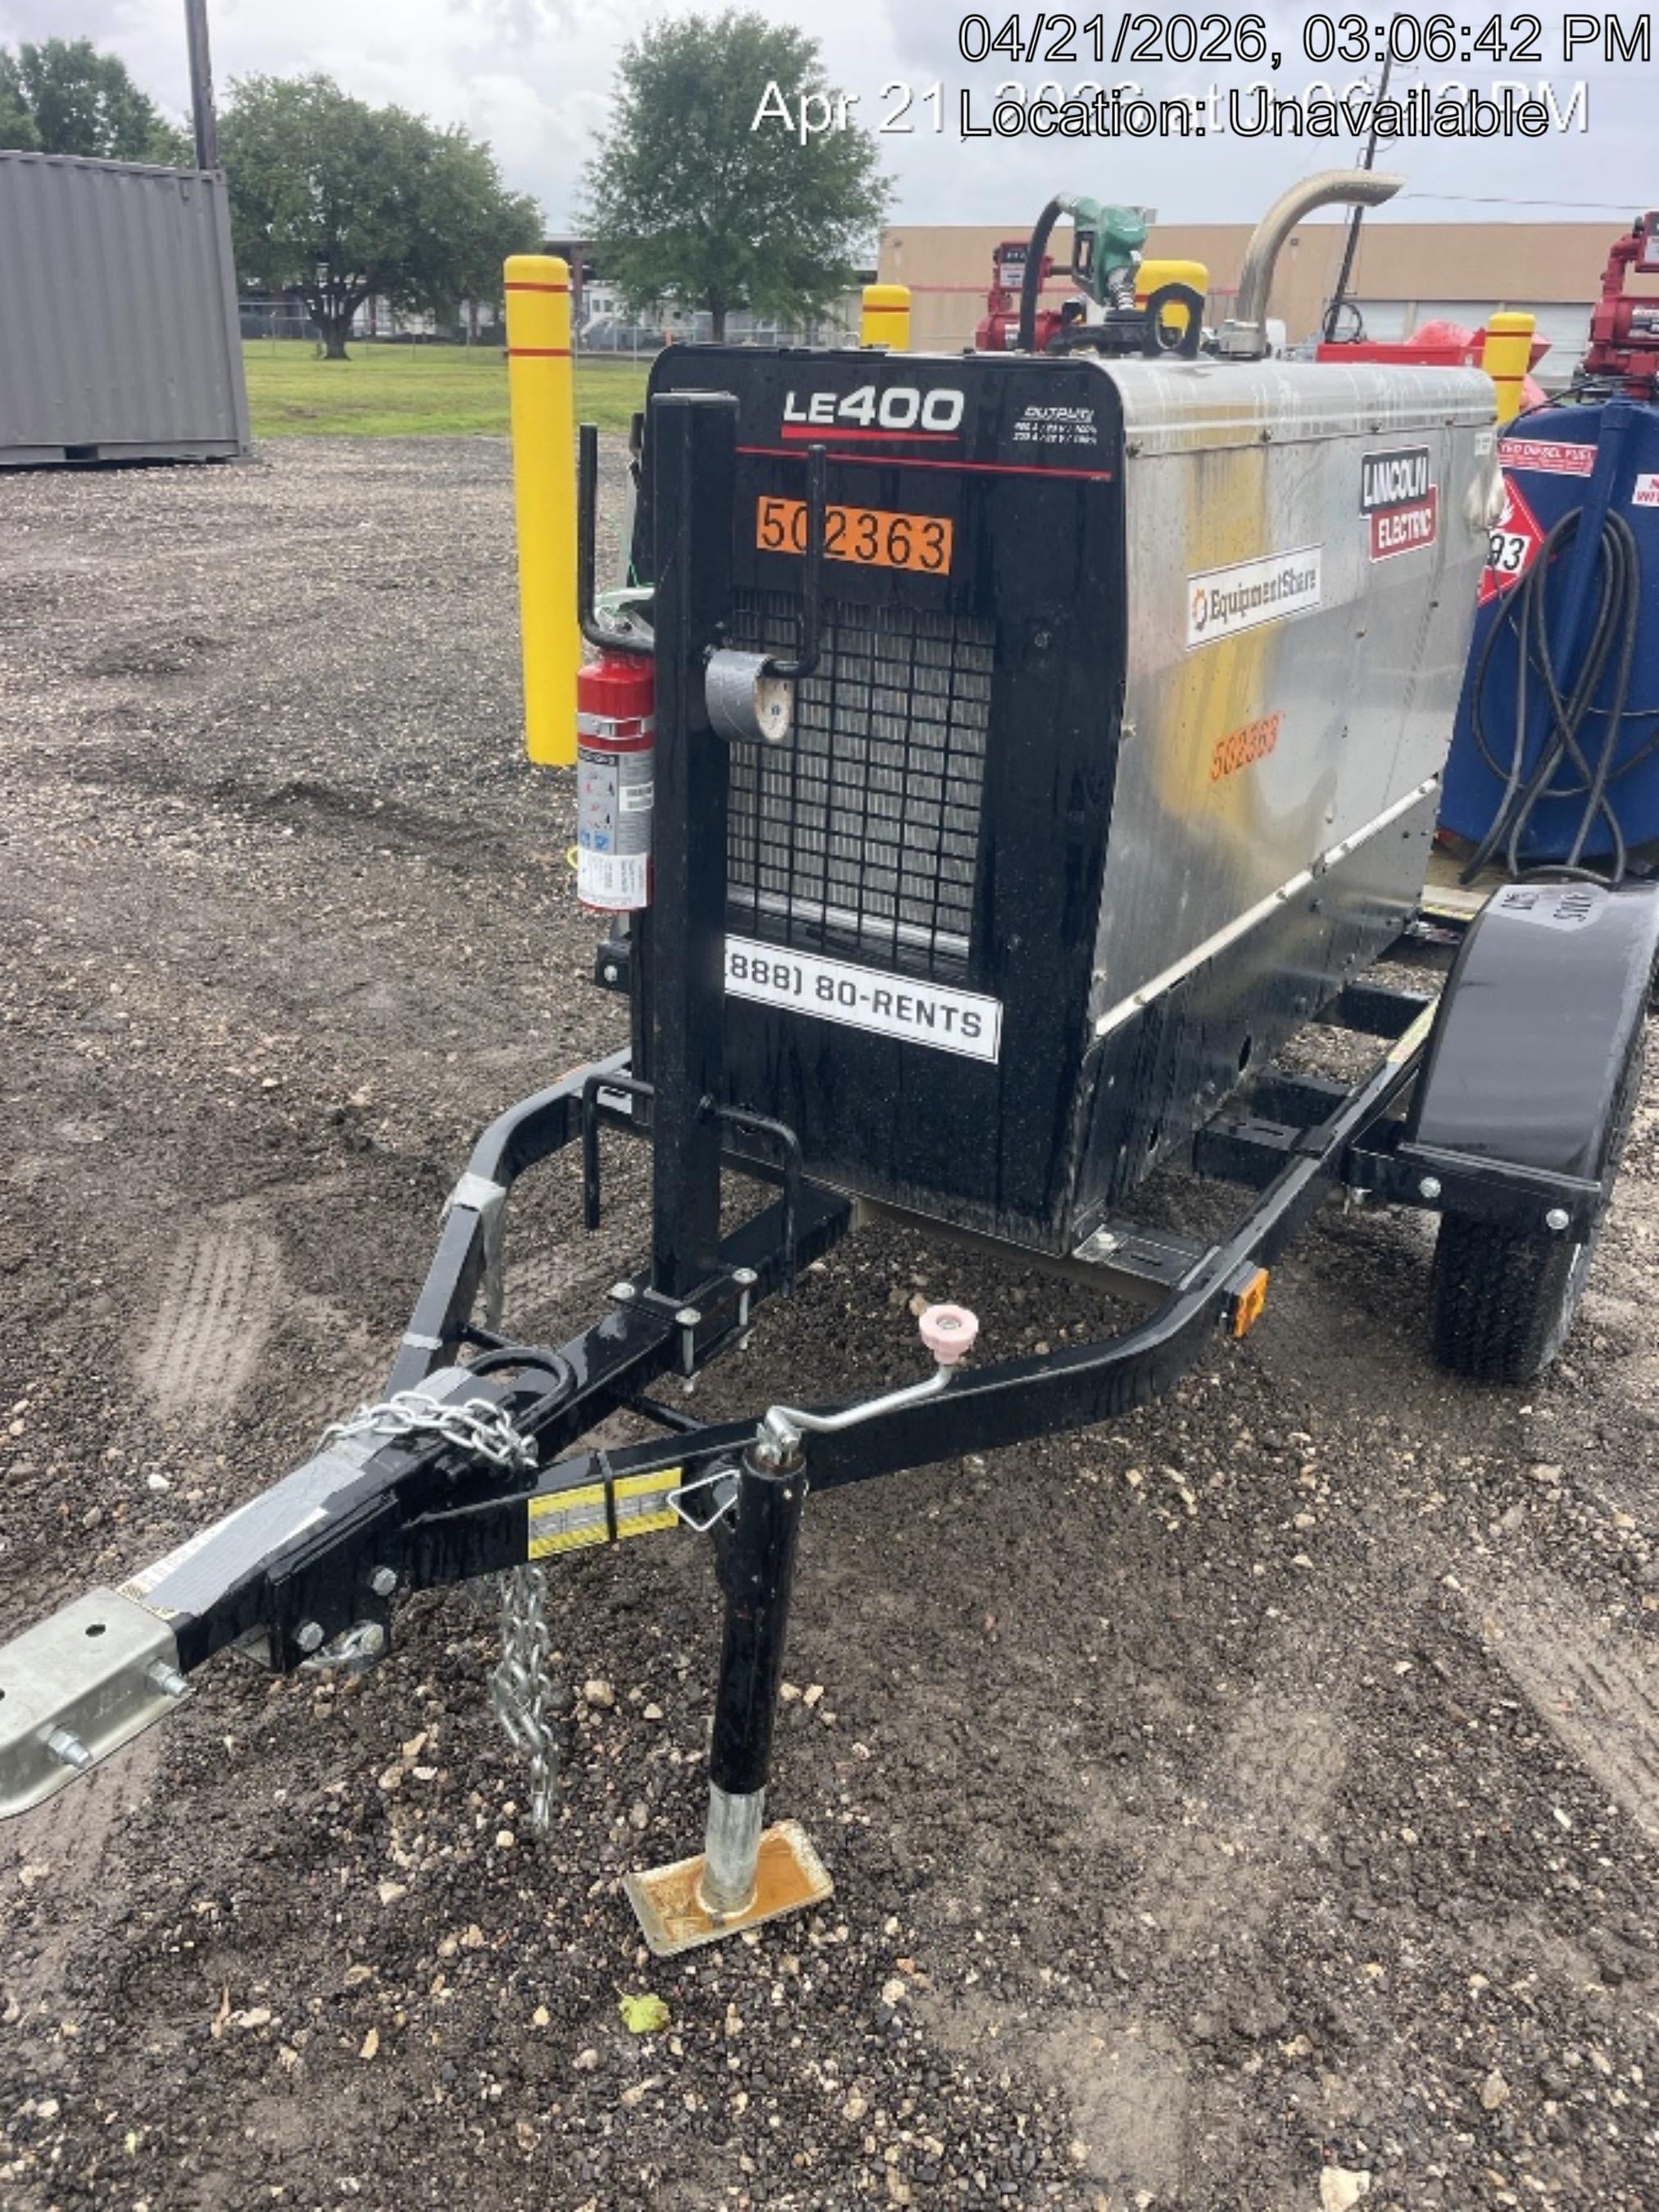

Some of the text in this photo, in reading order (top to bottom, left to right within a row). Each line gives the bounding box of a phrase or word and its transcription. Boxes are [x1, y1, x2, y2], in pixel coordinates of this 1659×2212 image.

[783, 385, 965, 432] LE400
[1363, 456, 1427, 507] LINCOLN
[761, 502, 945, 571] 502363
[1378, 508, 1432, 550] ELECTRIC
[1209, 567, 1317, 624] EquipmentShare
[725, 950, 983, 1039] 888) 80-RENTS
